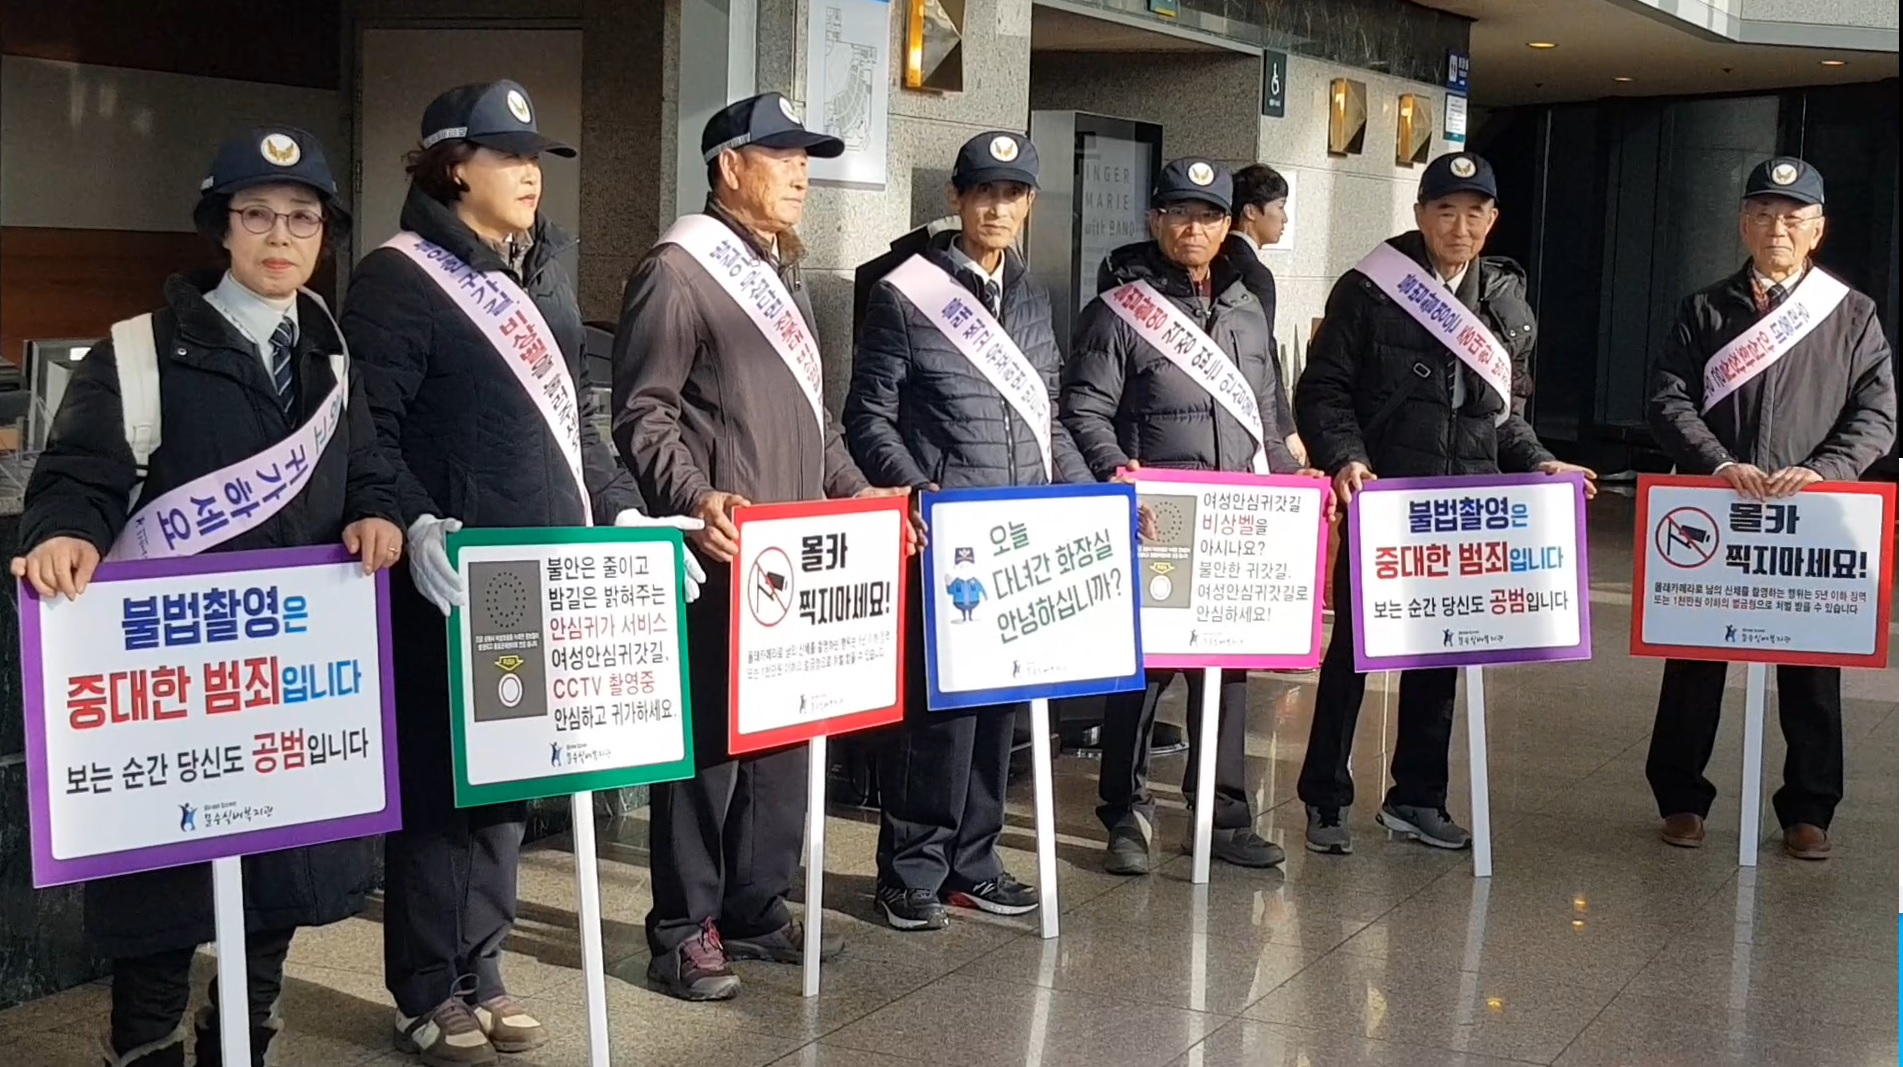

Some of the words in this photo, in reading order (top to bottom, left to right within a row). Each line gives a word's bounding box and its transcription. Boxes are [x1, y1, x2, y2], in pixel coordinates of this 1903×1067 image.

[1085, 164, 1130, 184] INGER
[1085, 191, 1130, 210] MARIE
[1109, 220, 1135, 237] BAND
[709, 239, 751, 277] 밤길이
[740, 270, 784, 319] 무섭다면
[775, 310, 804, 351] 전봇대
[1113, 283, 1168, 331] 불법촬영
[1161, 321, 1197, 354] 걱정
[1191, 346, 1223, 380] 없는
[1397, 273, 1463, 334] 불법촬영은
[1456, 325, 1495, 365] 중대한
[500, 310, 554, 380] 비상벨을
[942, 297, 974, 329] 몰래
[963, 318, 996, 352] 찍고
[985, 342, 1028, 391] 유포하면
[157, 444, 309, 551] 귀가하세요
[1203, 493, 1302, 513] 여성안심귀갓길
[1408, 496, 1529, 534] 불법촬영은
[1202, 513, 1268, 536] 비상벨을
[1729, 502, 1800, 534] 몰카
[801, 532, 849, 573] 몰카
[990, 521, 1030, 557] 오늘
[1200, 540, 1266, 556] 아시나요?
[547, 556, 597, 582] 불안은
[602, 555, 650, 578] 줄이고
[992, 552, 1053, 600] 다녀간
[1055, 528, 1113, 575] 화장실
[1199, 561, 1241, 579] 불안한
[1375, 543, 1452, 580] 중대한
[1459, 541, 1564, 577] 범죄입니다
[1725, 544, 1868, 579] 찍지마세요!
[548, 586, 598, 612] 밤길은
[604, 583, 666, 609] 밝혀주는
[799, 581, 891, 626] 찍지마세요!
[997, 567, 1123, 645] 안녕하십니까?
[1198, 584, 1308, 602] 여성안심귀갓길로
[1374, 600, 1402, 619] 보는
[1408, 597, 1436, 618] 순간
[1442, 595, 1485, 617] 당신도
[1490, 588, 1568, 615] 공범입니다
[1653, 595, 1670, 606] 또는
[1673, 596, 1702, 608] 1천만원
[1705, 598, 1730, 609] 이하의
[1732, 599, 1773, 611] 벌금형으로
[1775, 602, 1792, 612] 처벌
[1794, 603, 1811, 613] 받을
[1813, 603, 1823, 613] 수
[1824, 604, 1858, 615] 있습니다
[1654, 582, 1704, 595] 몰래카메라로
[1705, 585, 1722, 596] 남의
[1725, 586, 1749, 597] 신체를
[1752, 587, 1785, 599] 촬영하는
[1787, 589, 1812, 600] 행위는
[1814, 590, 1829, 601] 5년
[1831, 591, 1848, 601] 이하
[1850, 592, 1867, 603] 징역
[121, 586, 309, 651] 불법촬영은
[549, 616, 616, 642] 안심귀가
[621, 612, 668, 636] 서비스
[1196, 605, 1272, 622] 안심하세요!
[66, 664, 192, 730] 중대한
[203, 655, 362, 715] 범죄입니다
[553, 674, 603, 700] CCTV
[609, 670, 656, 698] 촬영중
[553, 704, 608, 733] 안심하고
[611, 698, 678, 727] 귀가하세요.
[66, 763, 114, 795] 보는
[122, 754, 169, 790] 순간
[177, 745, 245, 783] 당신도
[251, 727, 370, 775] 공범입니다
